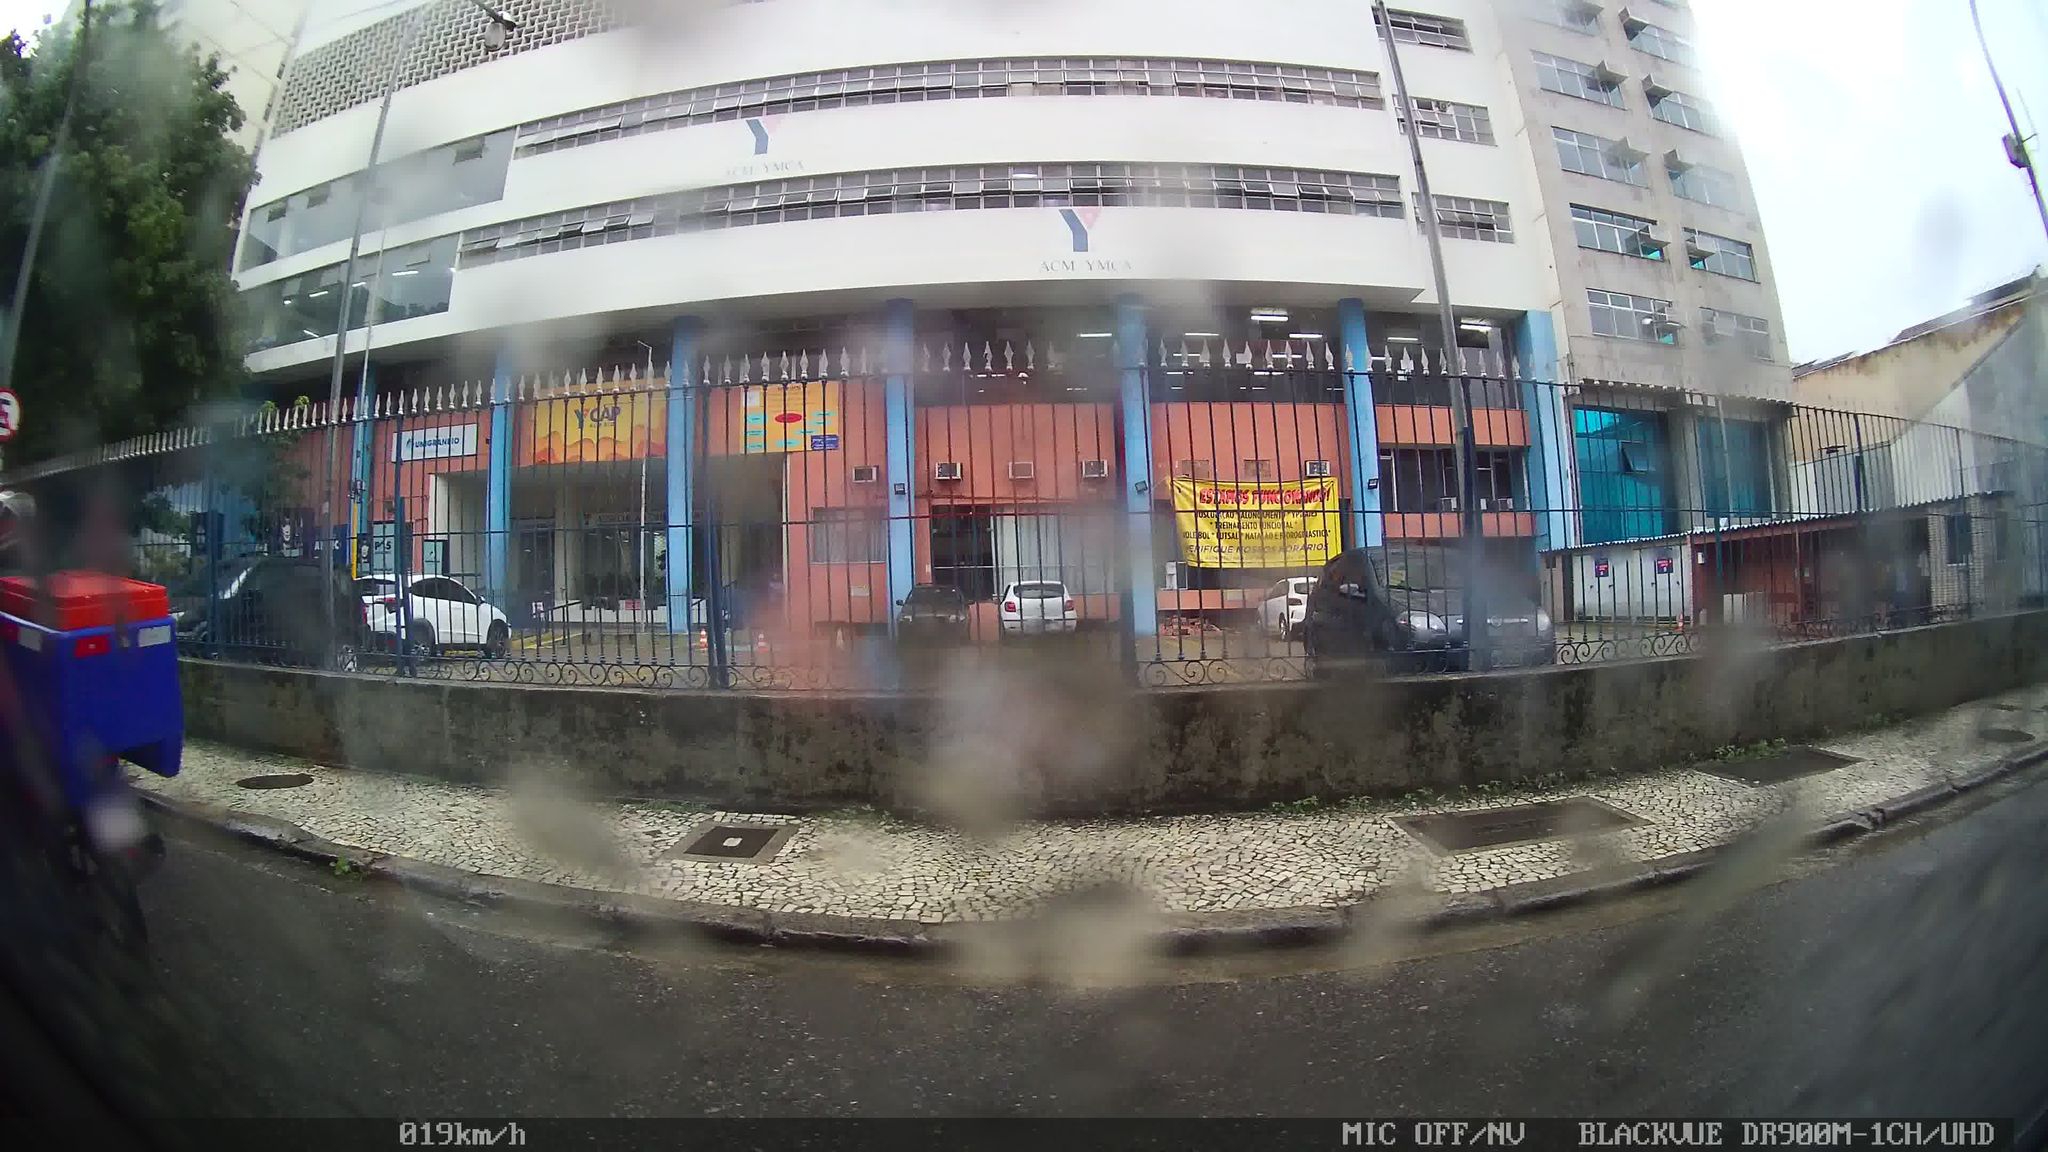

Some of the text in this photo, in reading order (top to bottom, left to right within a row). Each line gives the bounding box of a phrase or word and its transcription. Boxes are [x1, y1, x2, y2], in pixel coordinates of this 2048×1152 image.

[1040, 259, 1133, 273] ACM YMCA
[590, 405, 622, 423] CAP
[1259, 521, 1294, 530] UNCIOAL
[1183, 531, 1211, 540] VOLEBOL
[1215, 531, 1239, 541] UTSAL
[374, 540, 392, 551] PS
